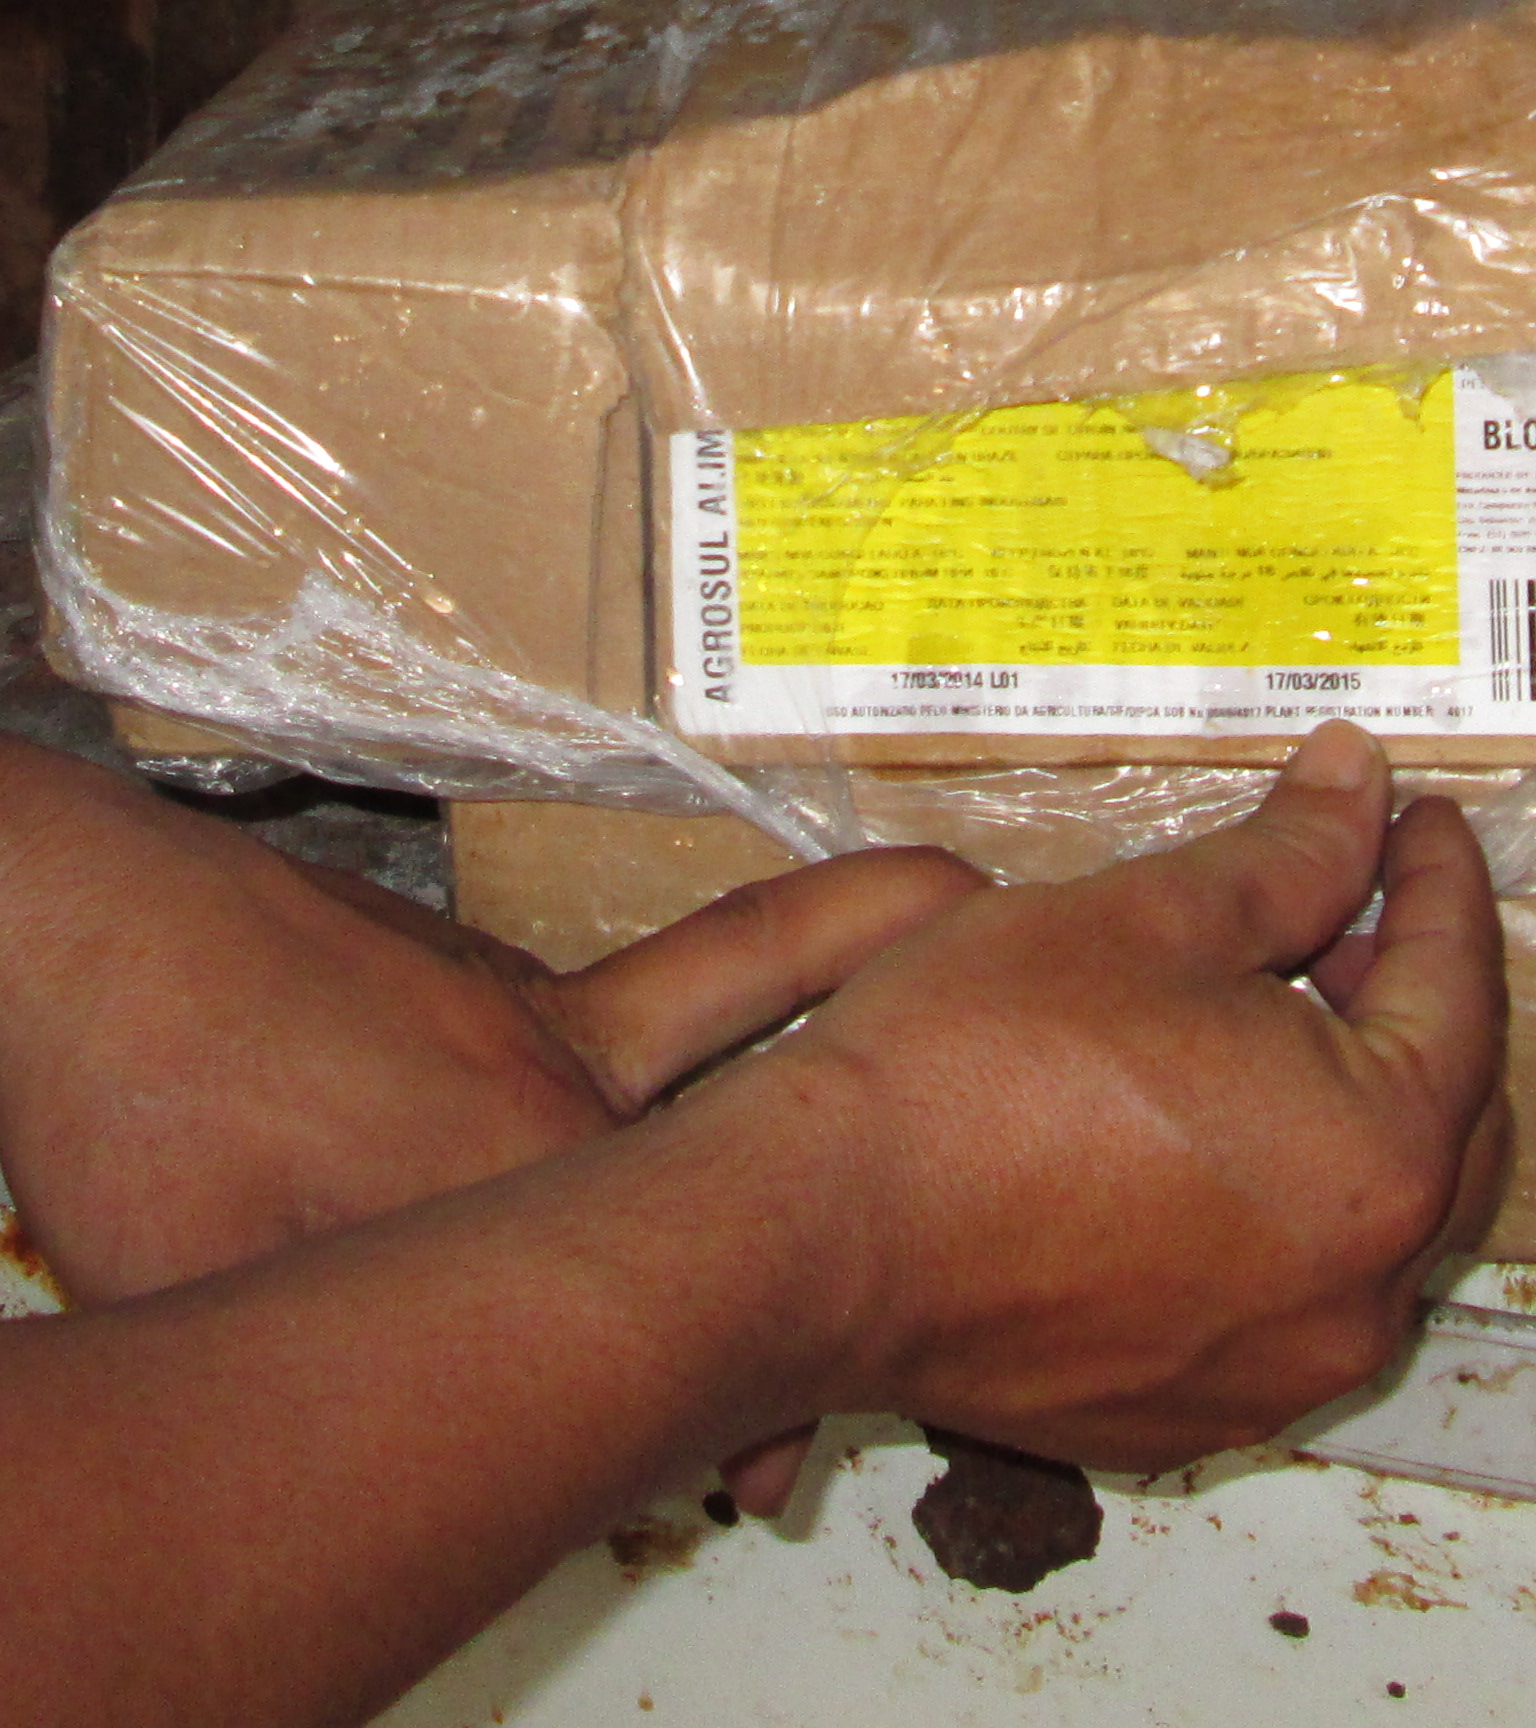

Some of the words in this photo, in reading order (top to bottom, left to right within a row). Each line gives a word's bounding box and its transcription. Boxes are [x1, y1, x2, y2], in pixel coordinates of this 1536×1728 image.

[698, 531, 735, 704] AGROSUL
[990, 672, 1020, 690] L01
[1265, 672, 1362, 691] 17/03/2015
